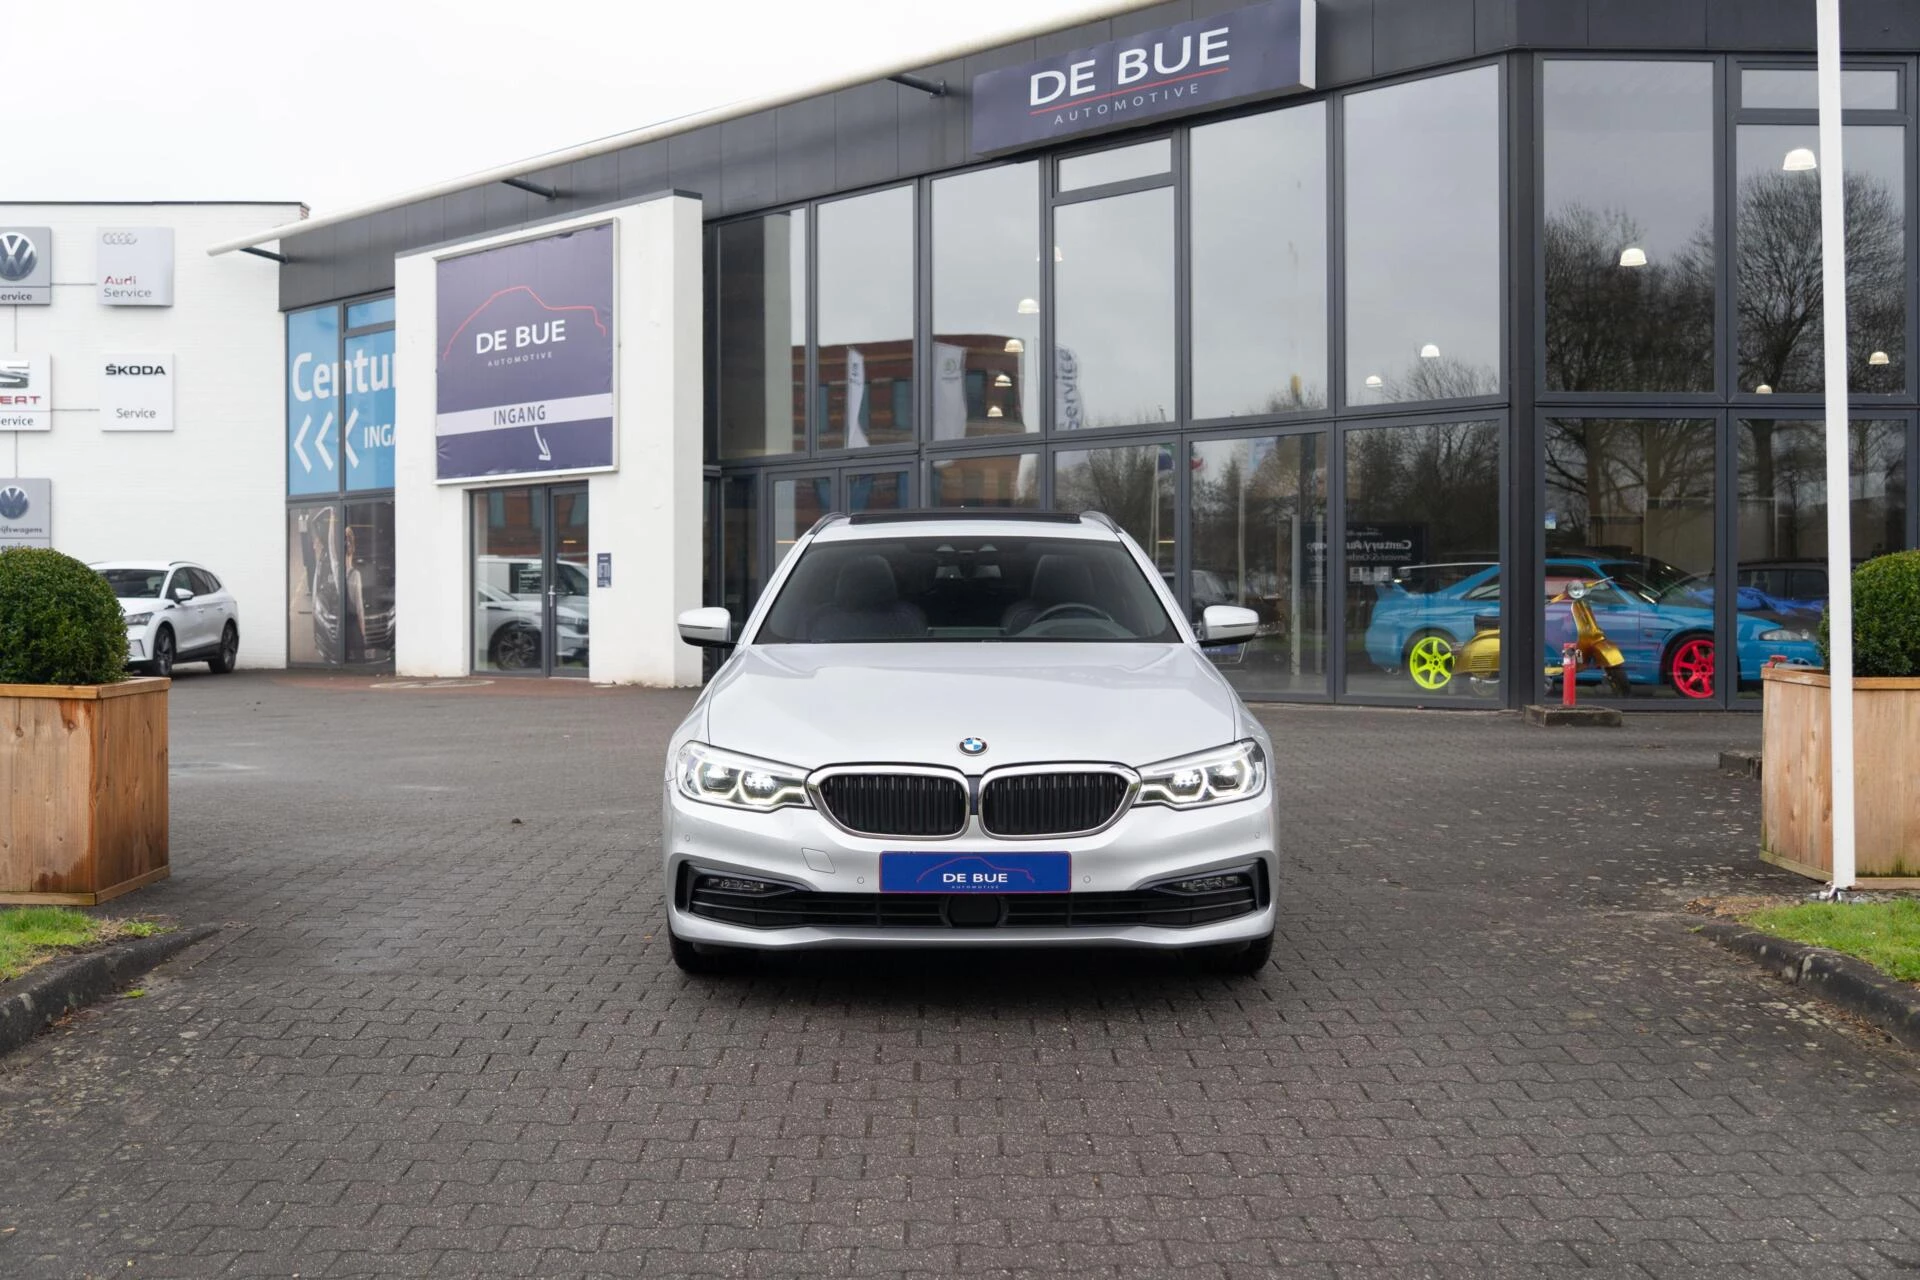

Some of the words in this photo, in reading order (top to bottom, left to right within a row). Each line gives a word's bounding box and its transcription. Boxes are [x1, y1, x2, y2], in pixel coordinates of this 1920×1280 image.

[1030, 59, 1096, 107] DE
[1117, 27, 1230, 85] BUE
[1054, 83, 1199, 126] AUTOMOTIVE
[104, 275, 137, 285] Audi
[0, 291, 32, 301] ervice
[103, 287, 152, 298] Service
[476, 329, 507, 355] DE
[515, 319, 566, 348] BUE
[487, 352, 553, 367] AUTOMOTIVE
[105, 363, 166, 376] ŠKODA
[0, 395, 41, 404] EAT
[116, 408, 156, 419] Service
[493, 405, 546, 426] INGANG
[0, 416, 34, 426] ervice
[943, 873, 967, 883] DE
[973, 873, 1009, 883] BUE
